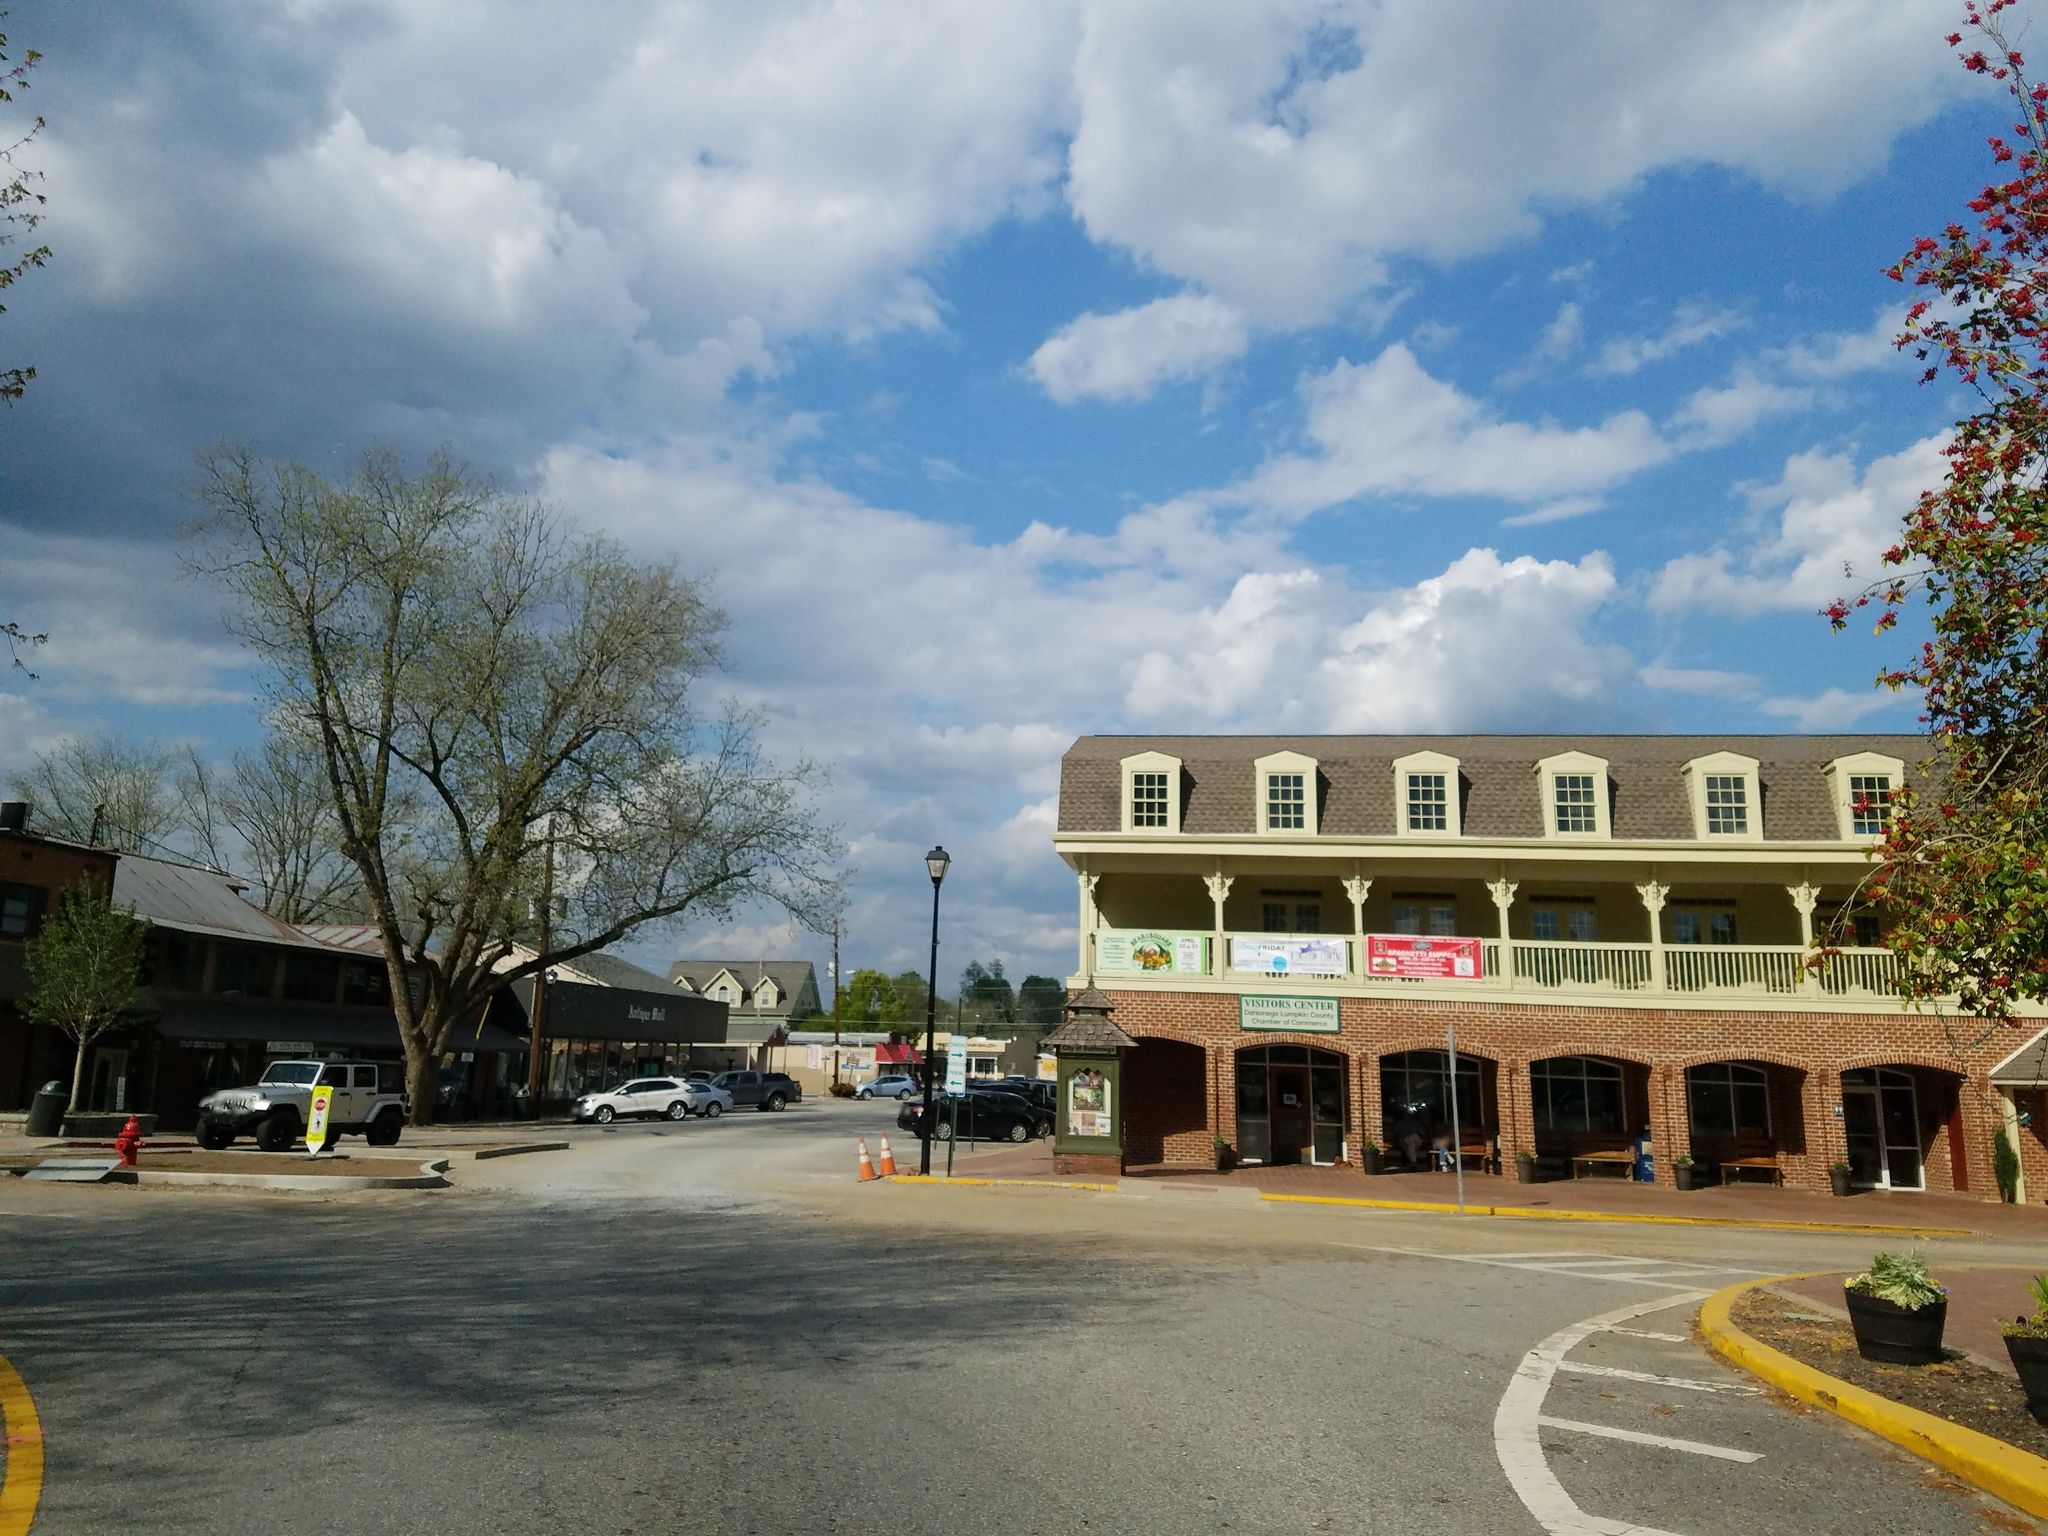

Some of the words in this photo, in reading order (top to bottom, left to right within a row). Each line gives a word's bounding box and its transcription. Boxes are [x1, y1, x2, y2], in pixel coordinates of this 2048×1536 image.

[1387, 949, 1427, 957] SPAGHETTI
[1429, 950, 1457, 959] SUPPER
[1244, 999, 1291, 1009] VISITORS
[1294, 1000, 1334, 1010] CENTER
[1280, 1010, 1309, 1018] Lumpkin
[1310, 1012, 1334, 1020] County
